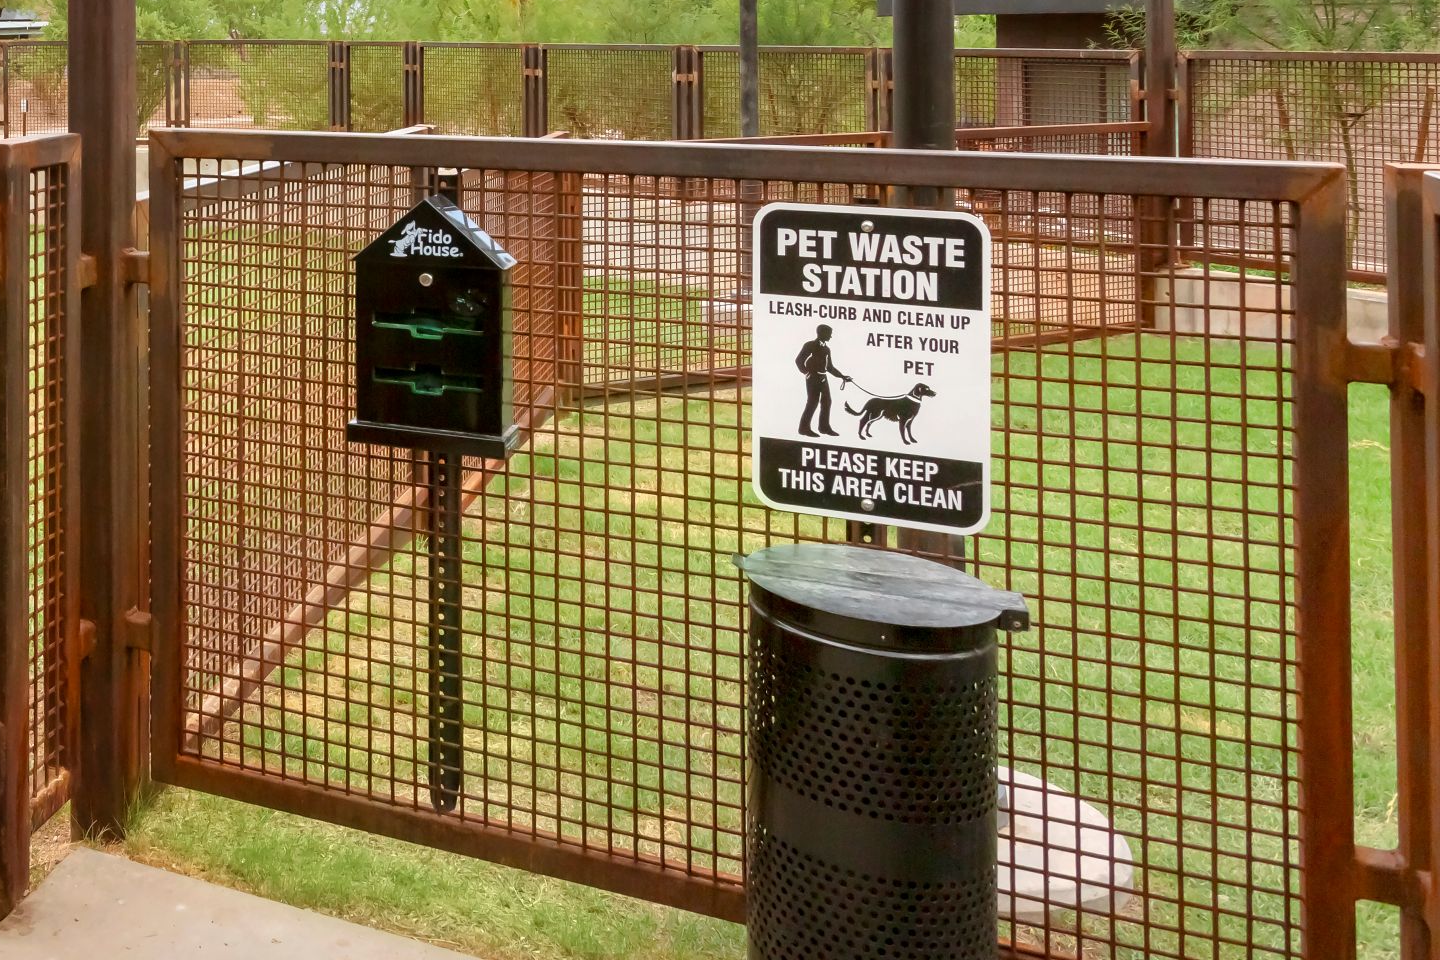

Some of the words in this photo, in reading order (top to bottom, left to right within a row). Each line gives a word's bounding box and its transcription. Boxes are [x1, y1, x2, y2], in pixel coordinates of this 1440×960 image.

[417, 228, 452, 244] Fido
[776, 227, 837, 259] PET
[849, 232, 965, 268] WASTE
[802, 263, 938, 302] STATION
[769, 300, 857, 321] LEASH-CURB
[862, 308, 892, 324] AND
[897, 311, 945, 328] CLEAN
[950, 315, 971, 330] UP
[866, 332, 913, 350] AFTER
[918, 337, 960, 354] YOUR
[903, 360, 935, 377] PET
[801, 447, 878, 476] PLEASE
[885, 456, 939, 482] KEEP
[778, 468, 825, 492] THIS
[831, 477, 886, 501] AREA
[893, 483, 962, 511] CLEAN
